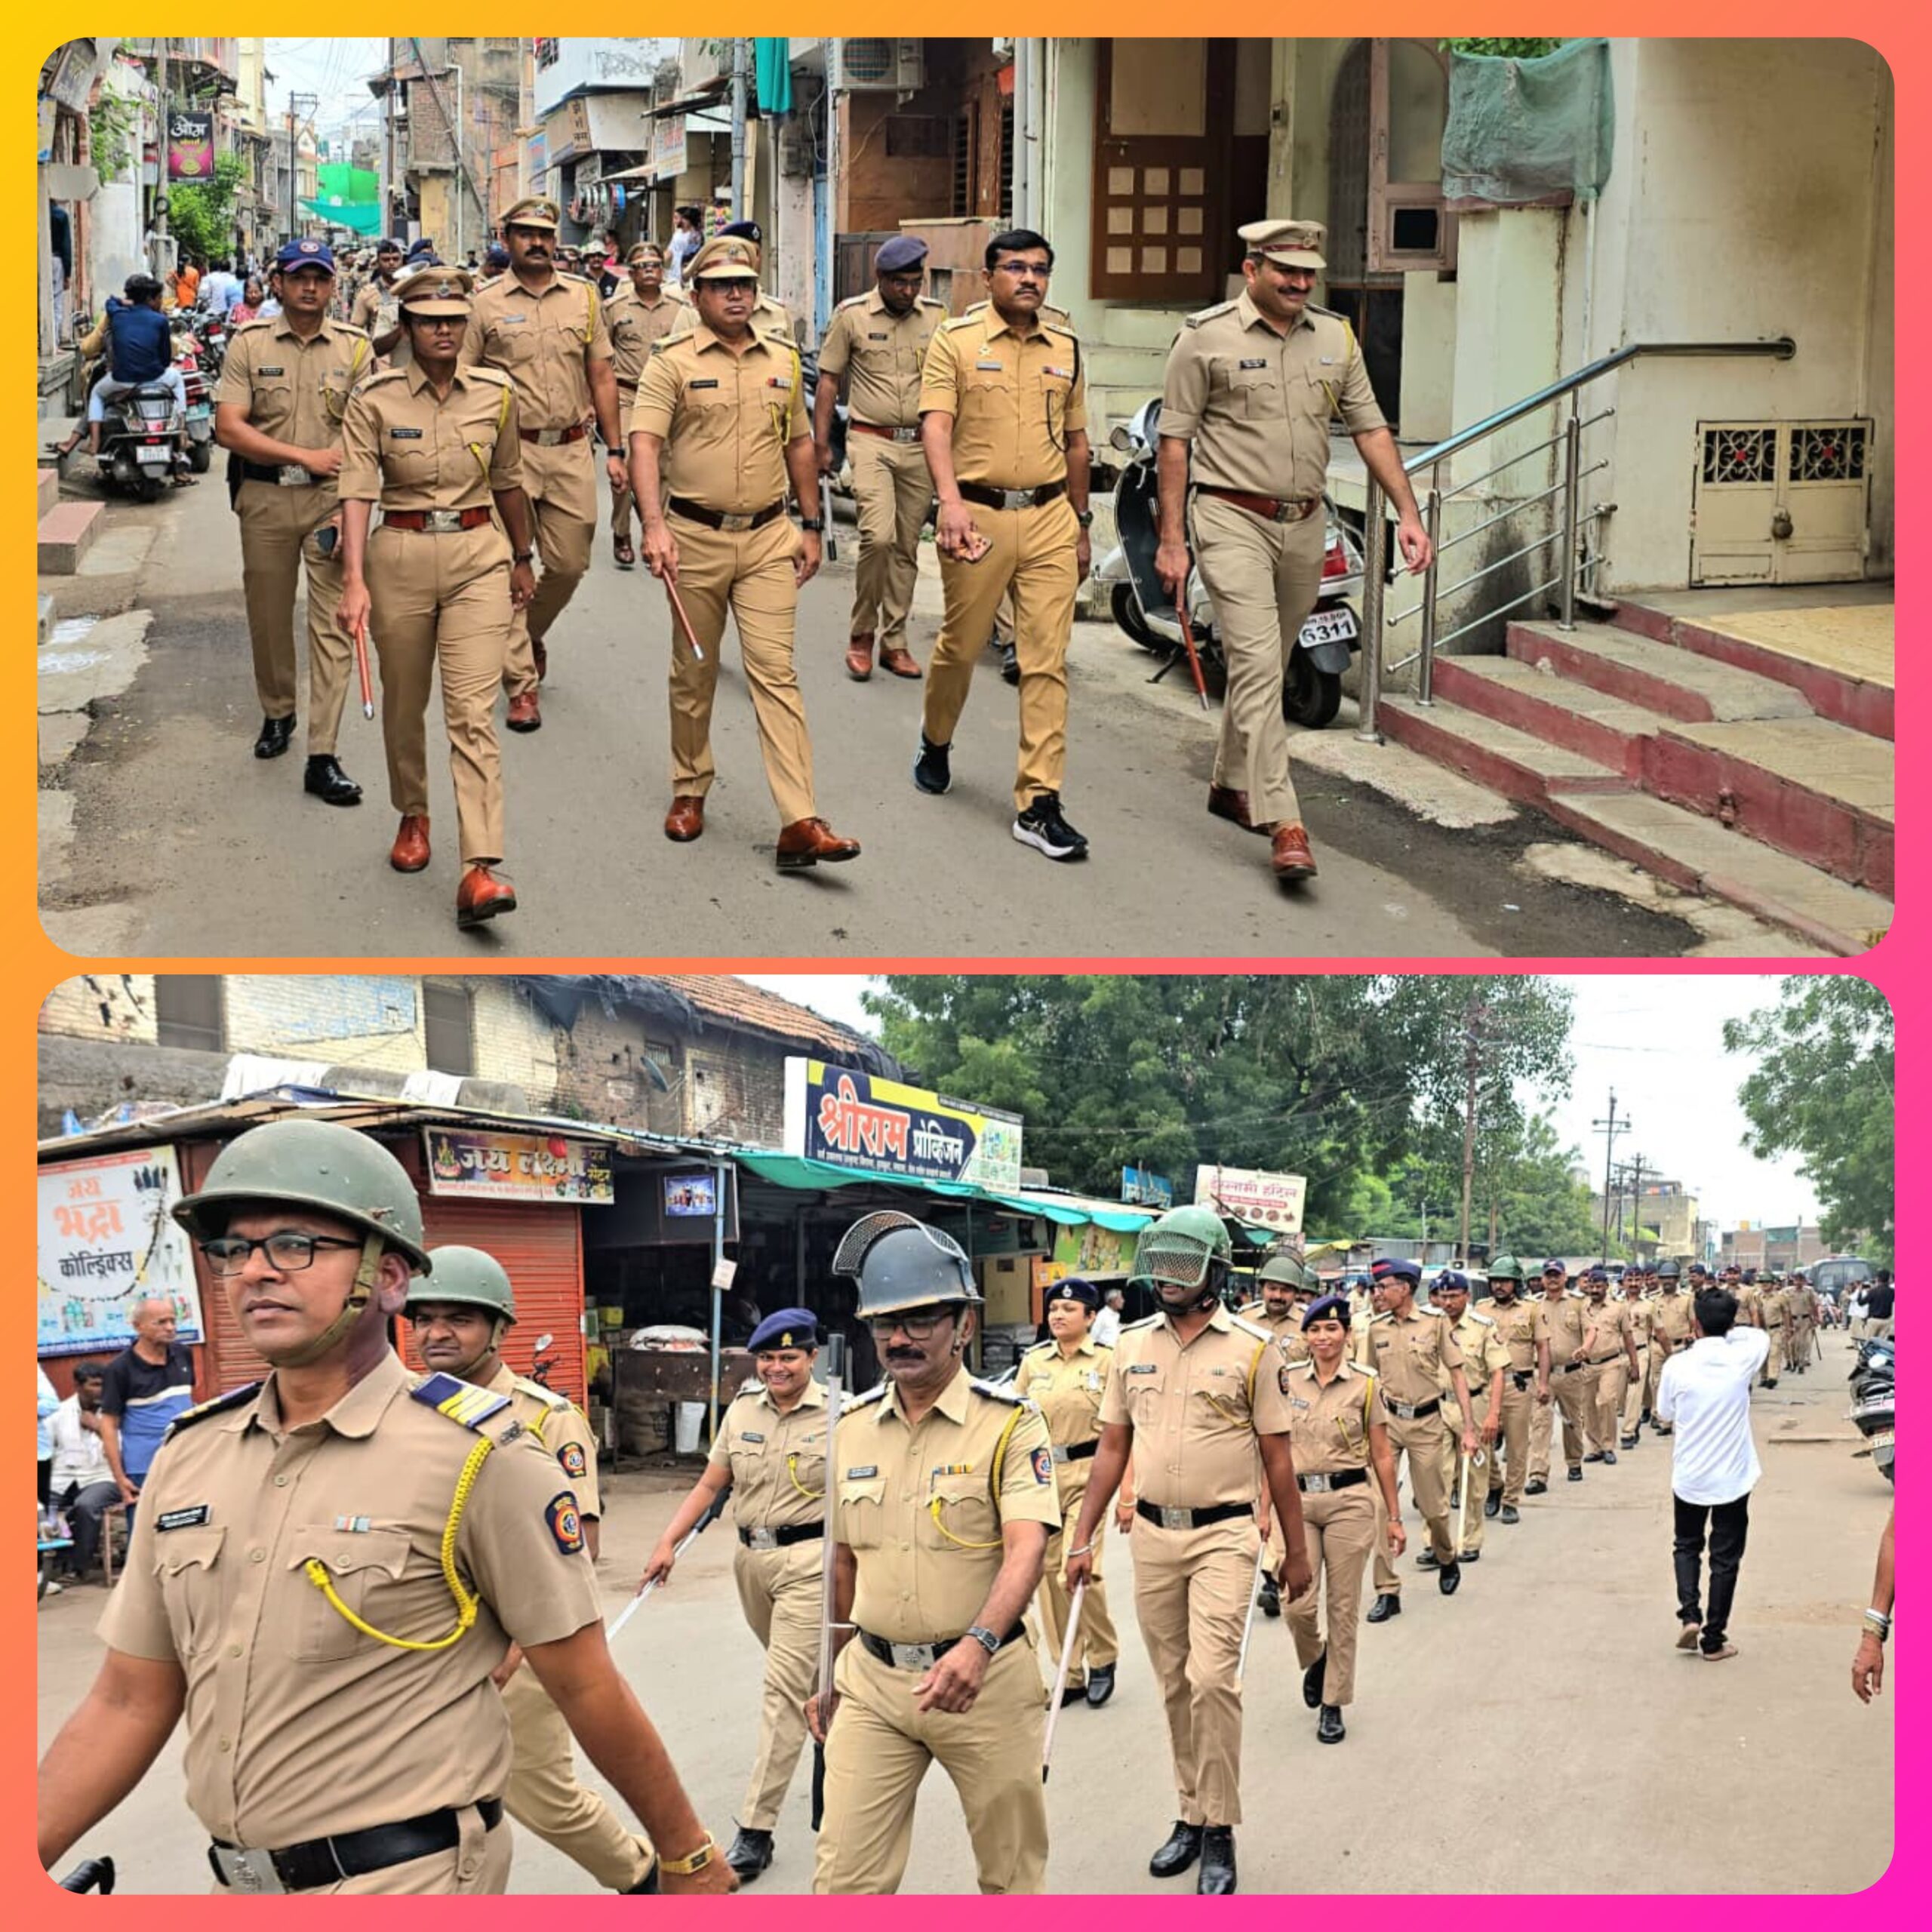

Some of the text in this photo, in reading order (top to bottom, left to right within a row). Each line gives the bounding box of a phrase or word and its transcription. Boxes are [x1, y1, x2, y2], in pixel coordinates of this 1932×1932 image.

[1303, 620, 1352, 643] 6311
[817, 1074, 911, 1161] श्रीराम
[912, 1118, 964, 1165] प्रोव्हिजन
[458, 1144, 512, 1174] जय
[64, 1175, 102, 1198] जय
[53, 1199, 125, 1244] भद्रा
